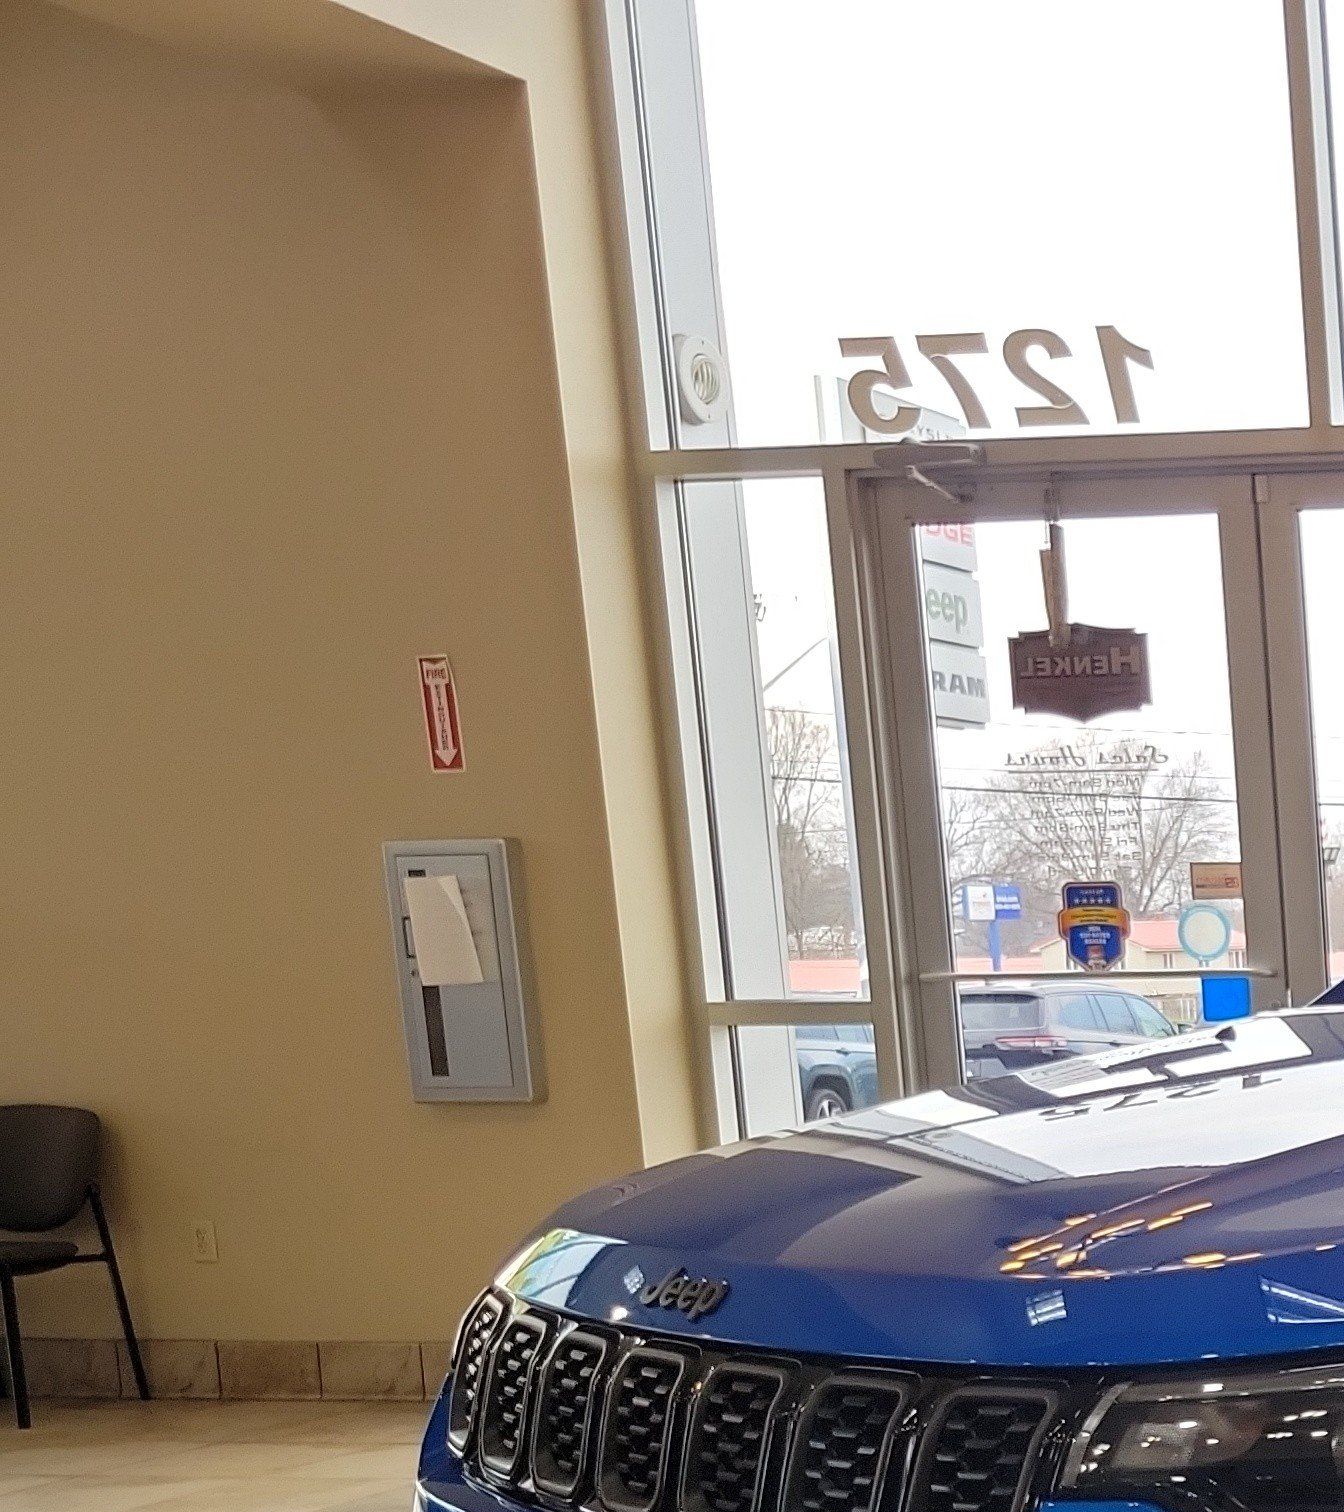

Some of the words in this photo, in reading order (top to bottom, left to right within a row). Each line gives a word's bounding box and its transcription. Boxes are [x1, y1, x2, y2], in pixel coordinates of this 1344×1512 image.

[925, 522, 974, 547] DGE
[926, 588, 969, 635] eep
[425, 667, 447, 679] FIRE
[932, 670, 986, 699] RAM
[639, 1266, 730, 1322] Jeep
